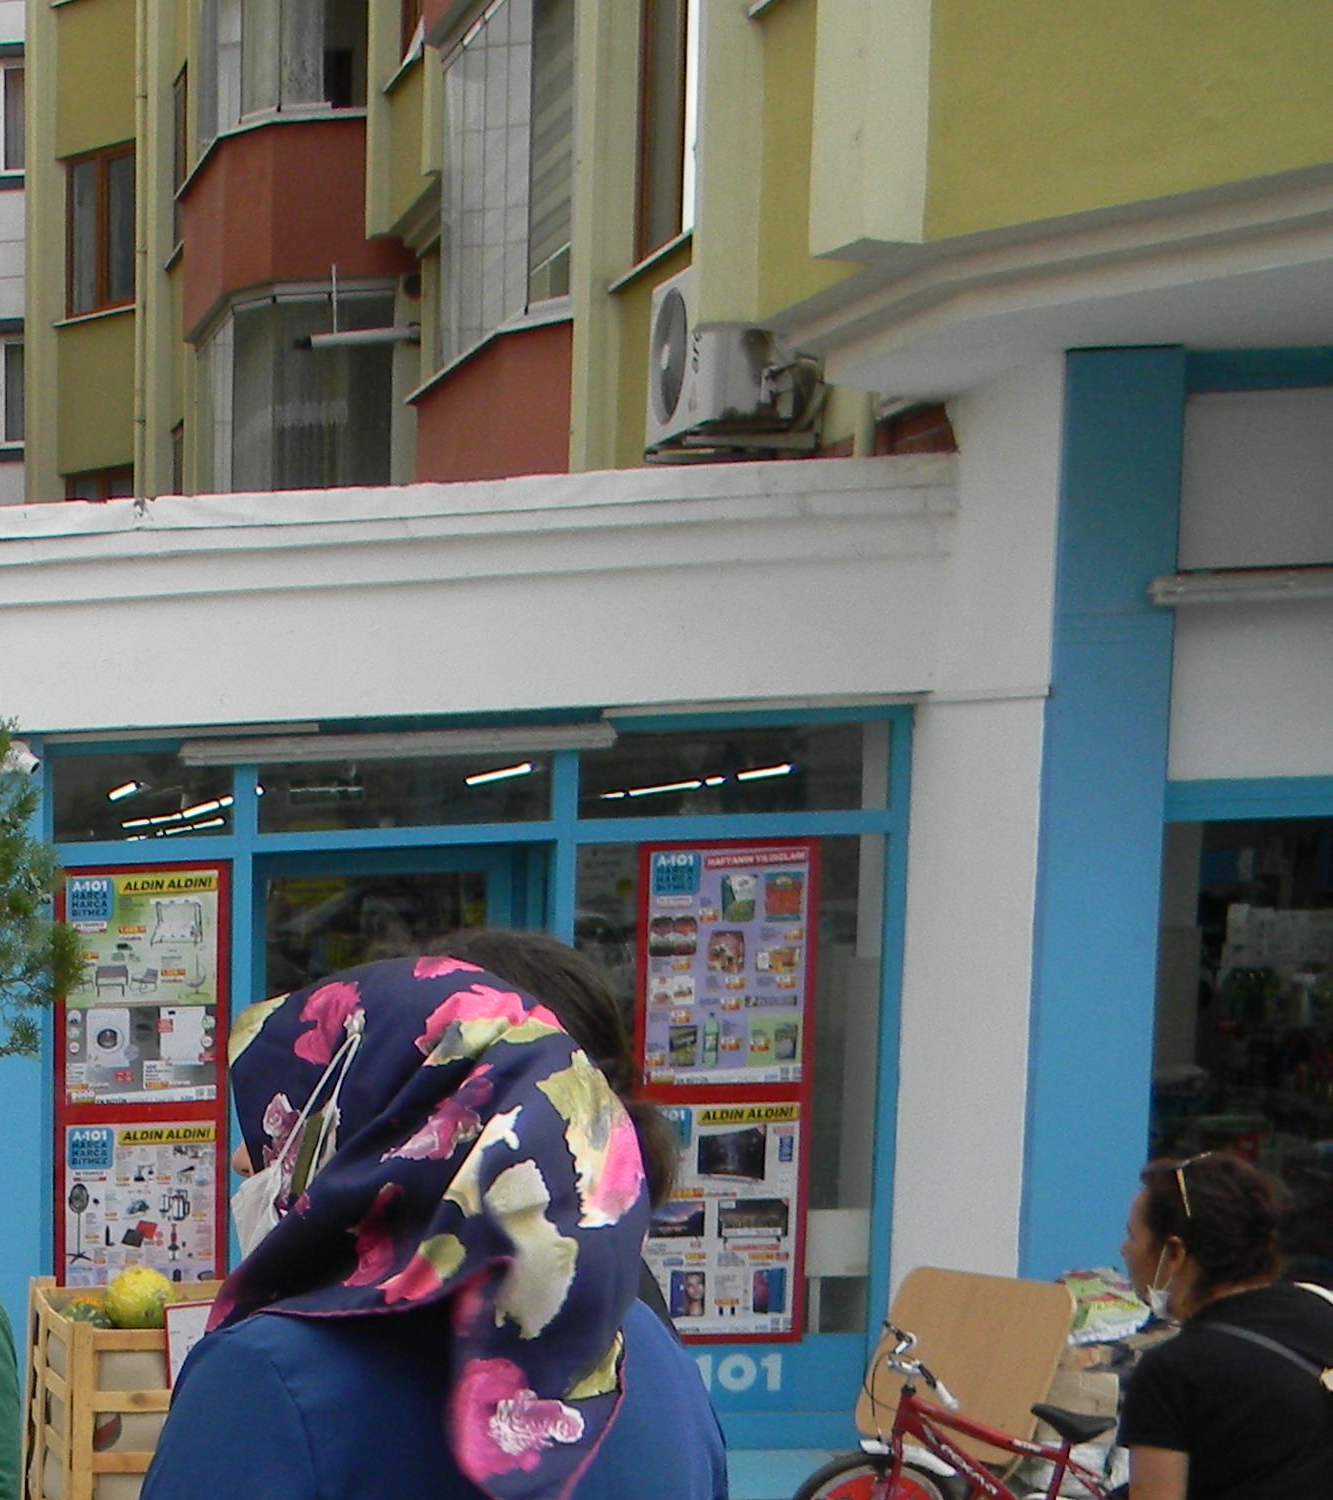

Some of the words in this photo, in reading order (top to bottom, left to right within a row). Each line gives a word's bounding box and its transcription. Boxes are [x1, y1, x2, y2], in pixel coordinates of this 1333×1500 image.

[124, 880, 164, 892] ALDIN
[167, 877, 212, 890] ALDIN!
[702, 1109, 744, 1120] ALDIN
[747, 1106, 793, 1118] ALDIN!
[123, 1130, 163, 1141] ALDIN
[166, 1128, 210, 1139] ALDIN!
